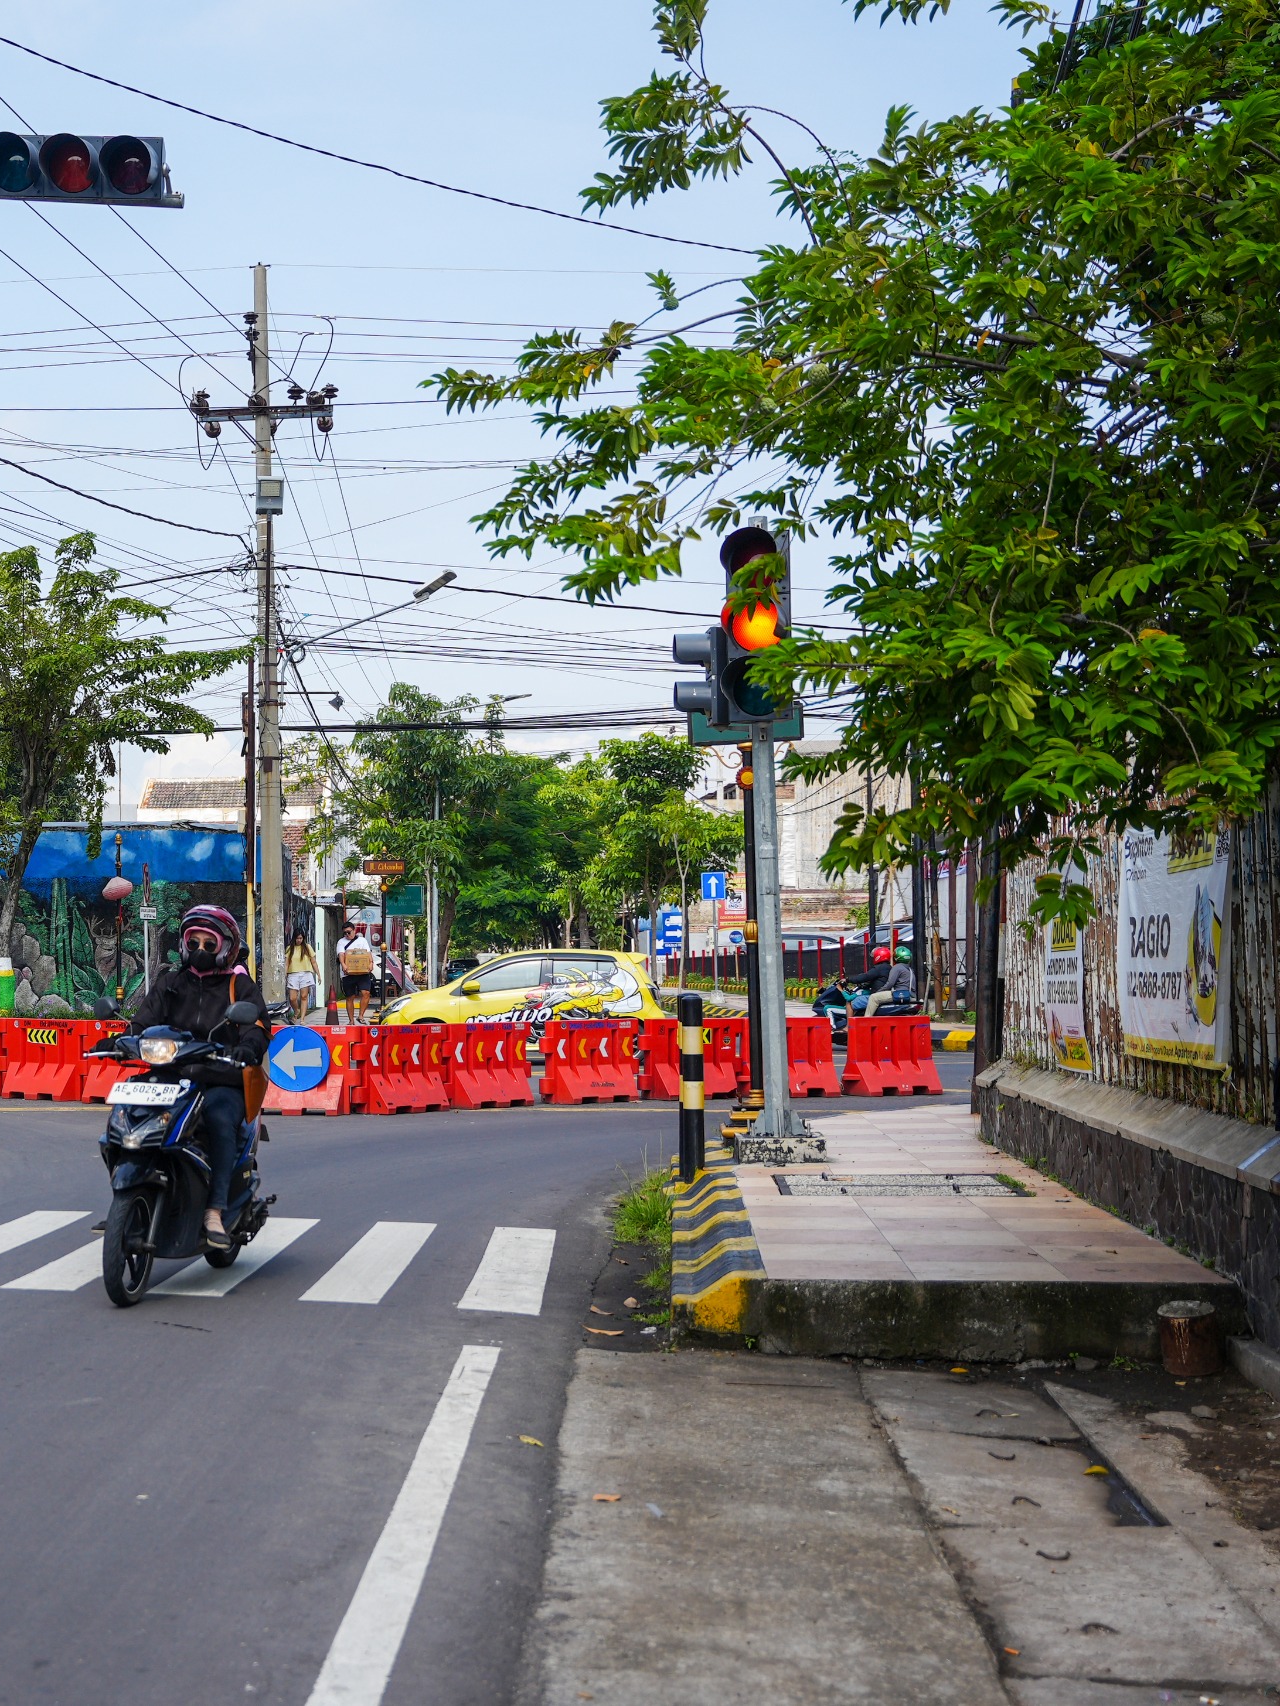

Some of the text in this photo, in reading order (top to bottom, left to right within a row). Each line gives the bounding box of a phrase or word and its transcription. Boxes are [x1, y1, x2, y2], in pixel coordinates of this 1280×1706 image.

[114, 1084, 176, 1095] AE 6026 BR
